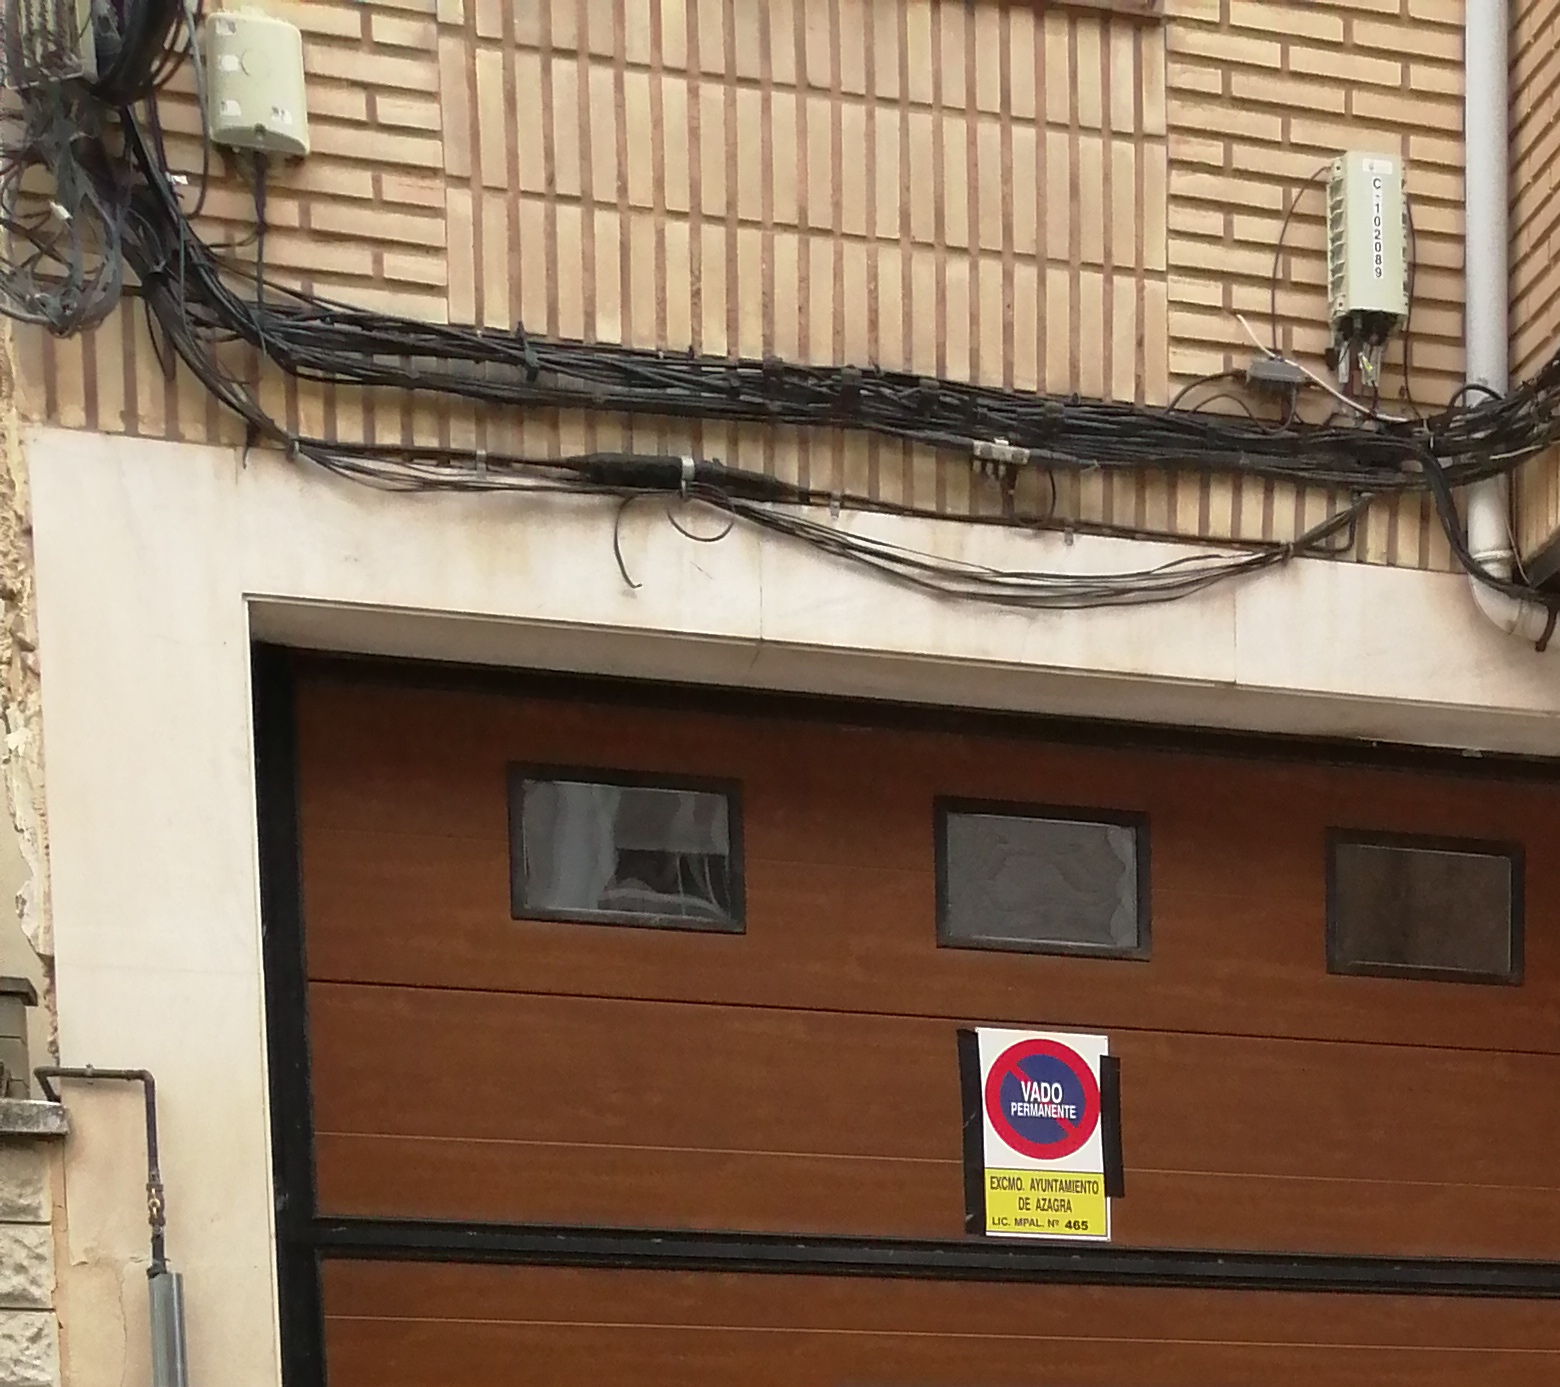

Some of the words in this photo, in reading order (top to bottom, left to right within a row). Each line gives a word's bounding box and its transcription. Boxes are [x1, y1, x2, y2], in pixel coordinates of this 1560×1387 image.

[1020, 1080, 1062, 1103] VADO
[1011, 1101, 1076, 1120] PERMANENTE
[990, 1176, 1024, 1192] EXCMO.
[1030, 1178, 1099, 1194] AYUNTAMIENTO
[1018, 1197, 1031, 1211] DE
[1036, 1198, 1072, 1212] AZAGRA
[992, 1217, 1010, 1227] LIC.
[1064, 1220, 1089, 1231] 465
